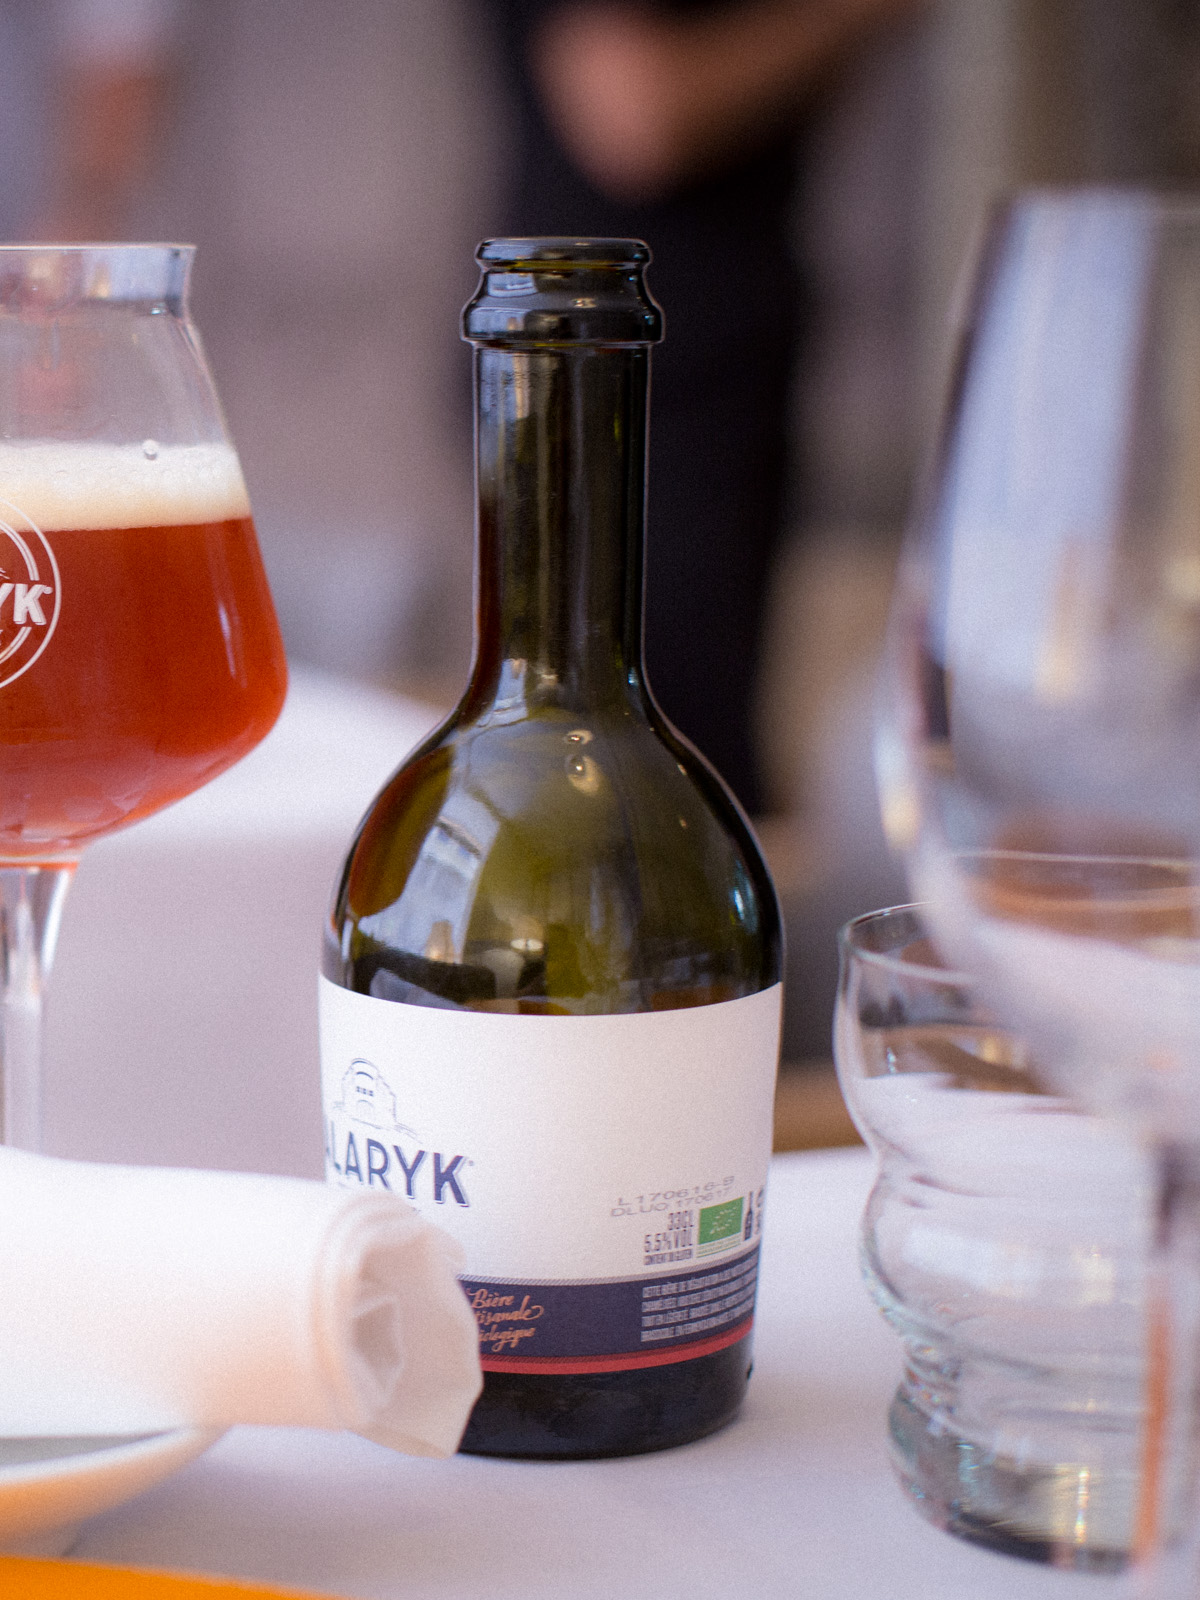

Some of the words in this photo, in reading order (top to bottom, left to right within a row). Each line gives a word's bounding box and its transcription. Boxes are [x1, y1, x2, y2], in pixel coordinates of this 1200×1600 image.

[325, 1120, 470, 1208] LARYK
[466, 1288, 515, 1309] Bière
[480, 1324, 536, 1352] iologique
